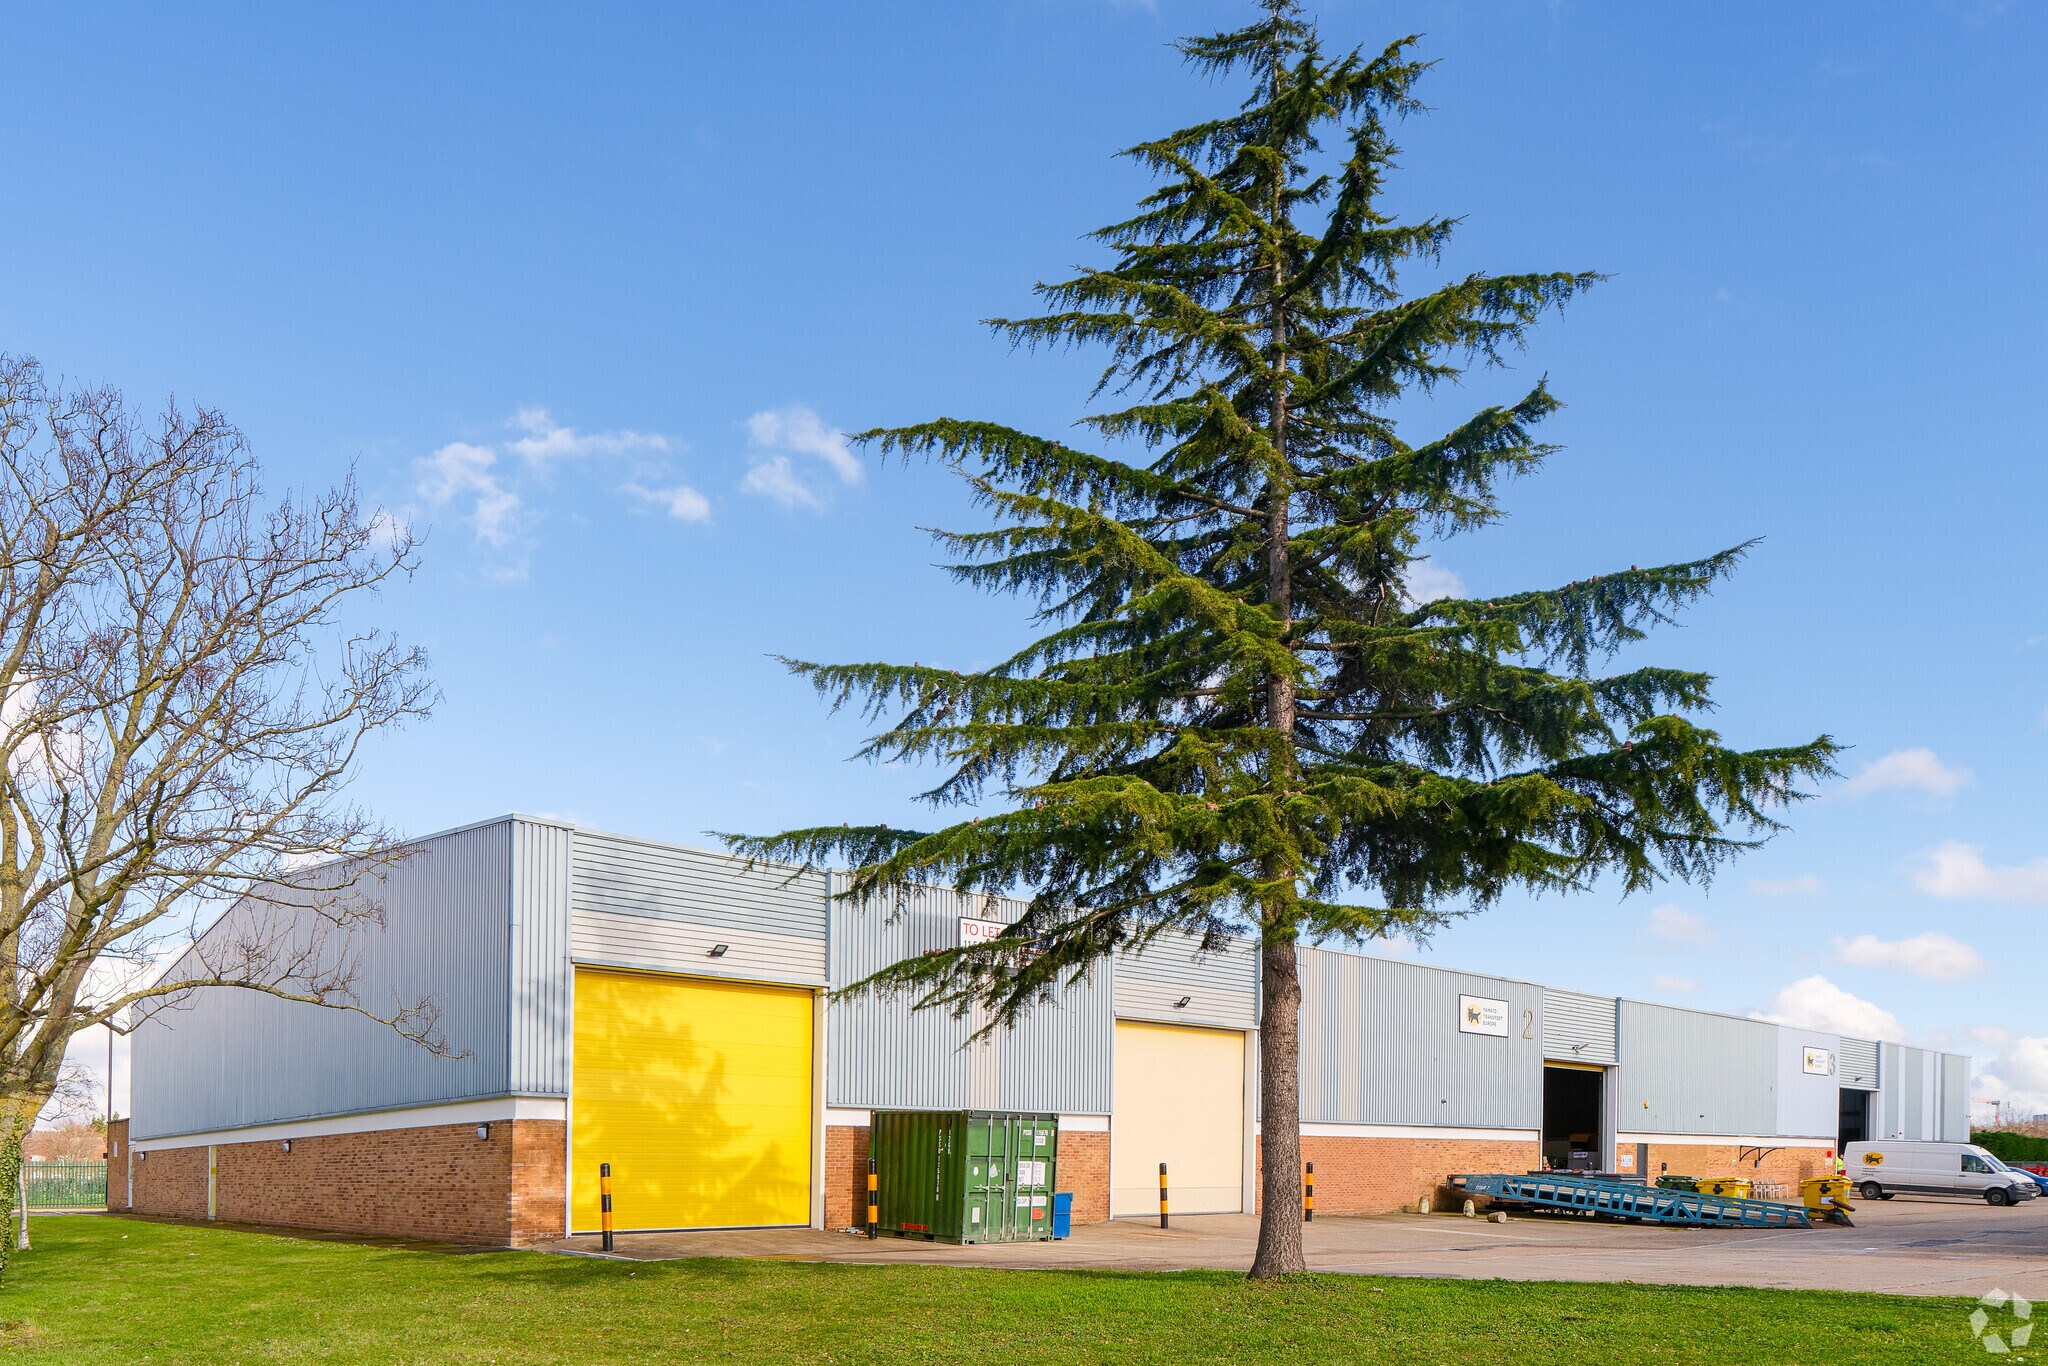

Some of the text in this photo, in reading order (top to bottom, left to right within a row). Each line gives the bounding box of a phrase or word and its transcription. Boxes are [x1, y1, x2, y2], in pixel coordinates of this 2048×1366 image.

[963, 923, 1000, 938] TO LET
[1523, 1008, 1533, 1039] 2
[1830, 1054, 1835, 1075] 3
